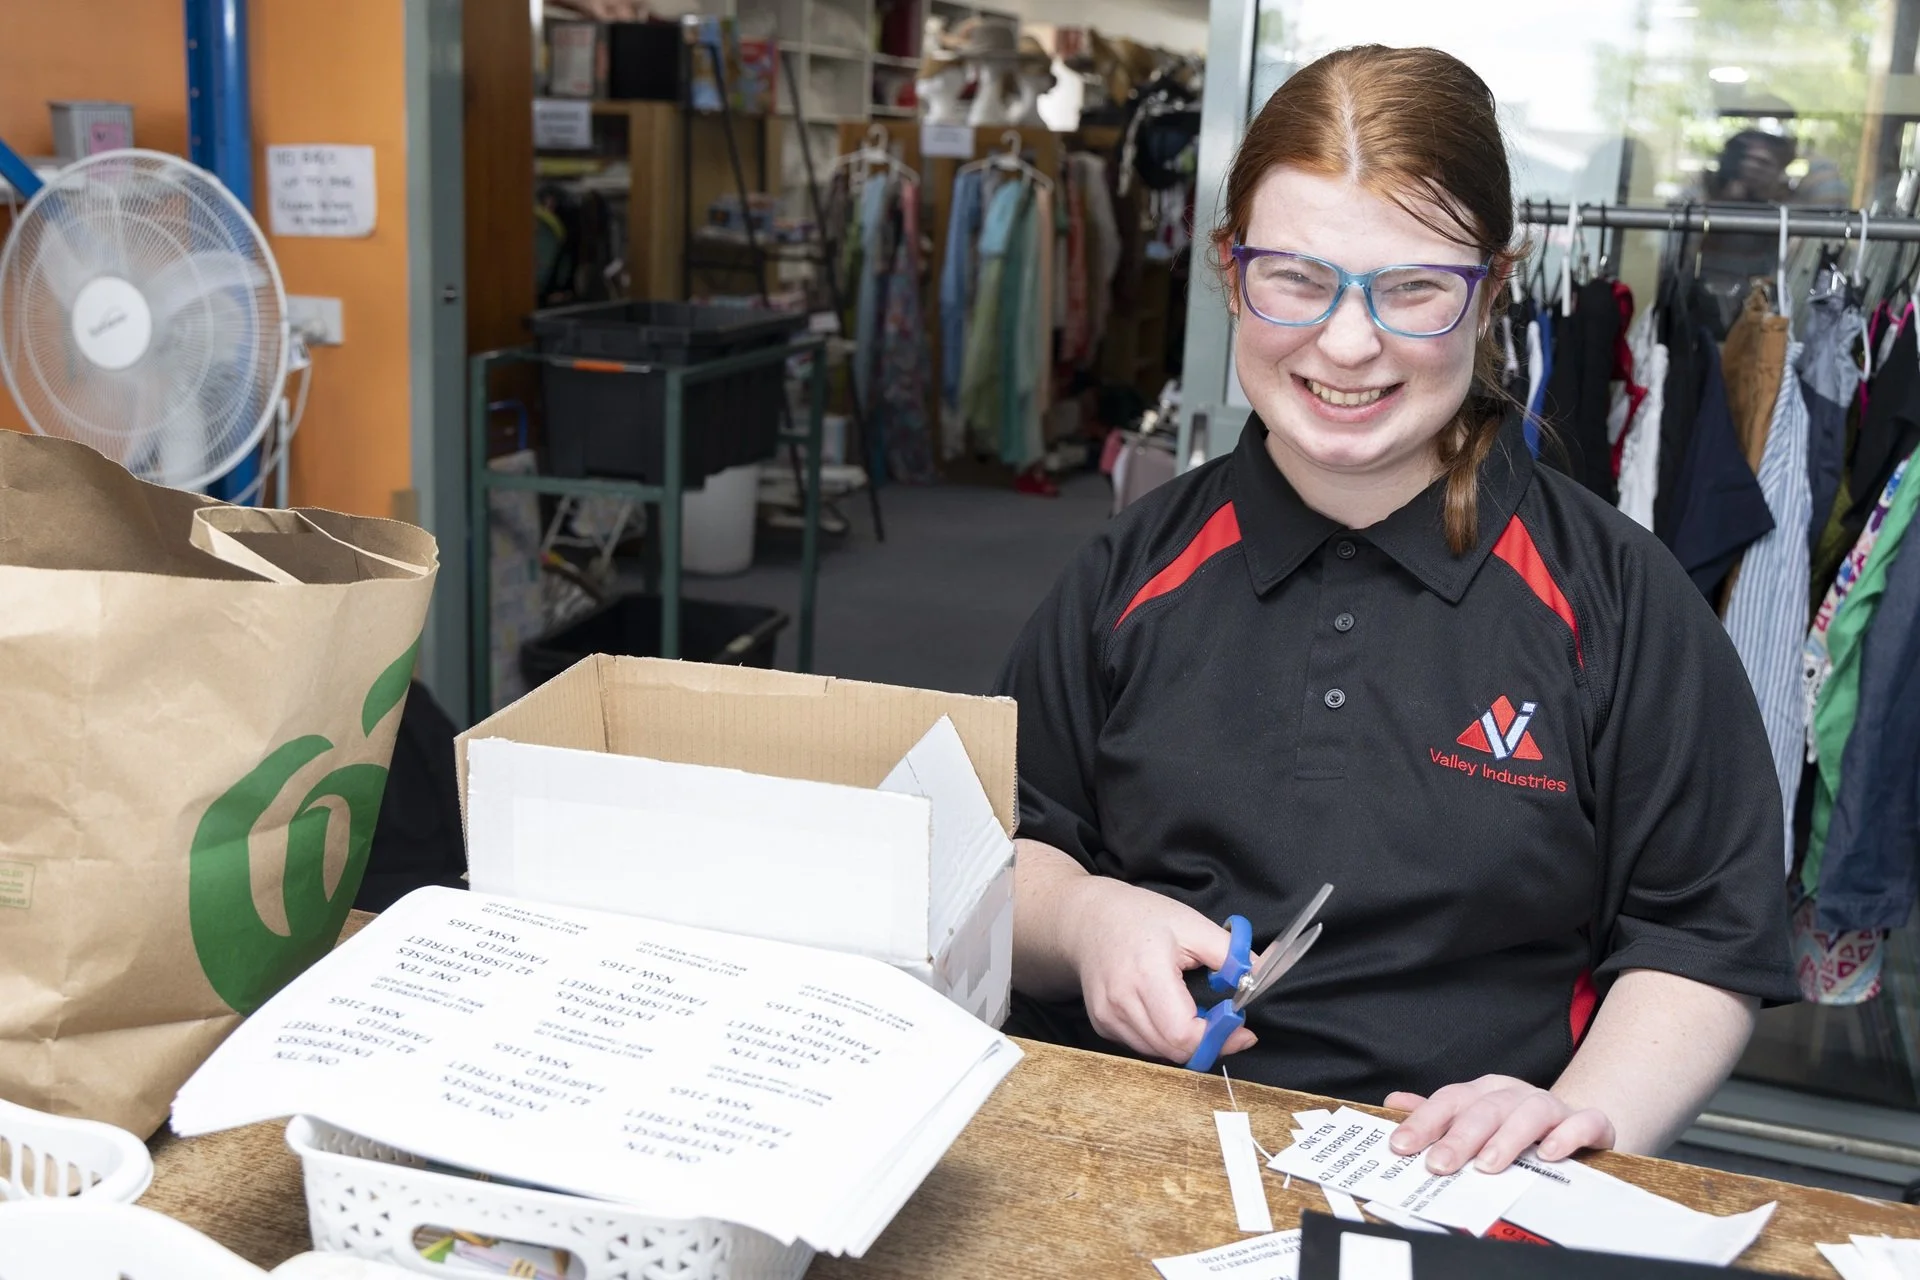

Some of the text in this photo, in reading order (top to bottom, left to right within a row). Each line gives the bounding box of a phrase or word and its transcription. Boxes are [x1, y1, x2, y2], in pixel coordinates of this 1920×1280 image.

[1429, 747, 1568, 792] Valley Industries
[447, 918, 520, 943] NSW 2165
[396, 947, 492, 978] ENTERPRISES
[404, 935, 534, 975] 42 LISBON STREET
[476, 941, 549, 965] FAIRFIELD
[395, 962, 461, 983] ONE TEN
[598, 960, 675, 984] NSW 2165
[328, 996, 405, 1019] NSW 2165
[555, 991, 655, 1021] ENTERPRISES
[558, 978, 694, 1016] 42 LISBON STREET
[632, 983, 708, 1006] FAIRFIELD
[556, 1006, 625, 1028] ONE TEN
[764, 1002, 845, 1027] NSW 2165
[281, 1020, 416, 1054] 42 LISBON STREET
[356, 1017, 433, 1044] FAIRFIELD
[725, 1020, 870, 1064] 42 LISBON STREET
[801, 1025, 880, 1055] FAIRFIELD
[273, 1051, 340, 1065] ONE TEN
[274, 1035, 374, 1058] ENTERPRISES
[492, 1042, 573, 1069] NSW 2165
[725, 1033, 830, 1064] ENTERPRISES
[729, 1048, 800, 1069] ONE TEN
[440, 1075, 547, 1112] ENTERPRISES
[445, 1061, 591, 1105] 42 LISBON STREET
[525, 1068, 607, 1093] FAIRFIELD
[441, 1093, 514, 1119] ONE TEN
[1298, 1123, 1337, 1150] ONE TEN
[1311, 1124, 1364, 1163] ENTERPRISES
[1318, 1128, 1386, 1182] 42 LISBON STREET
[1338, 1159, 1380, 1190] FAIRFIELD
[1380, 1163, 1403, 1181] NSW
